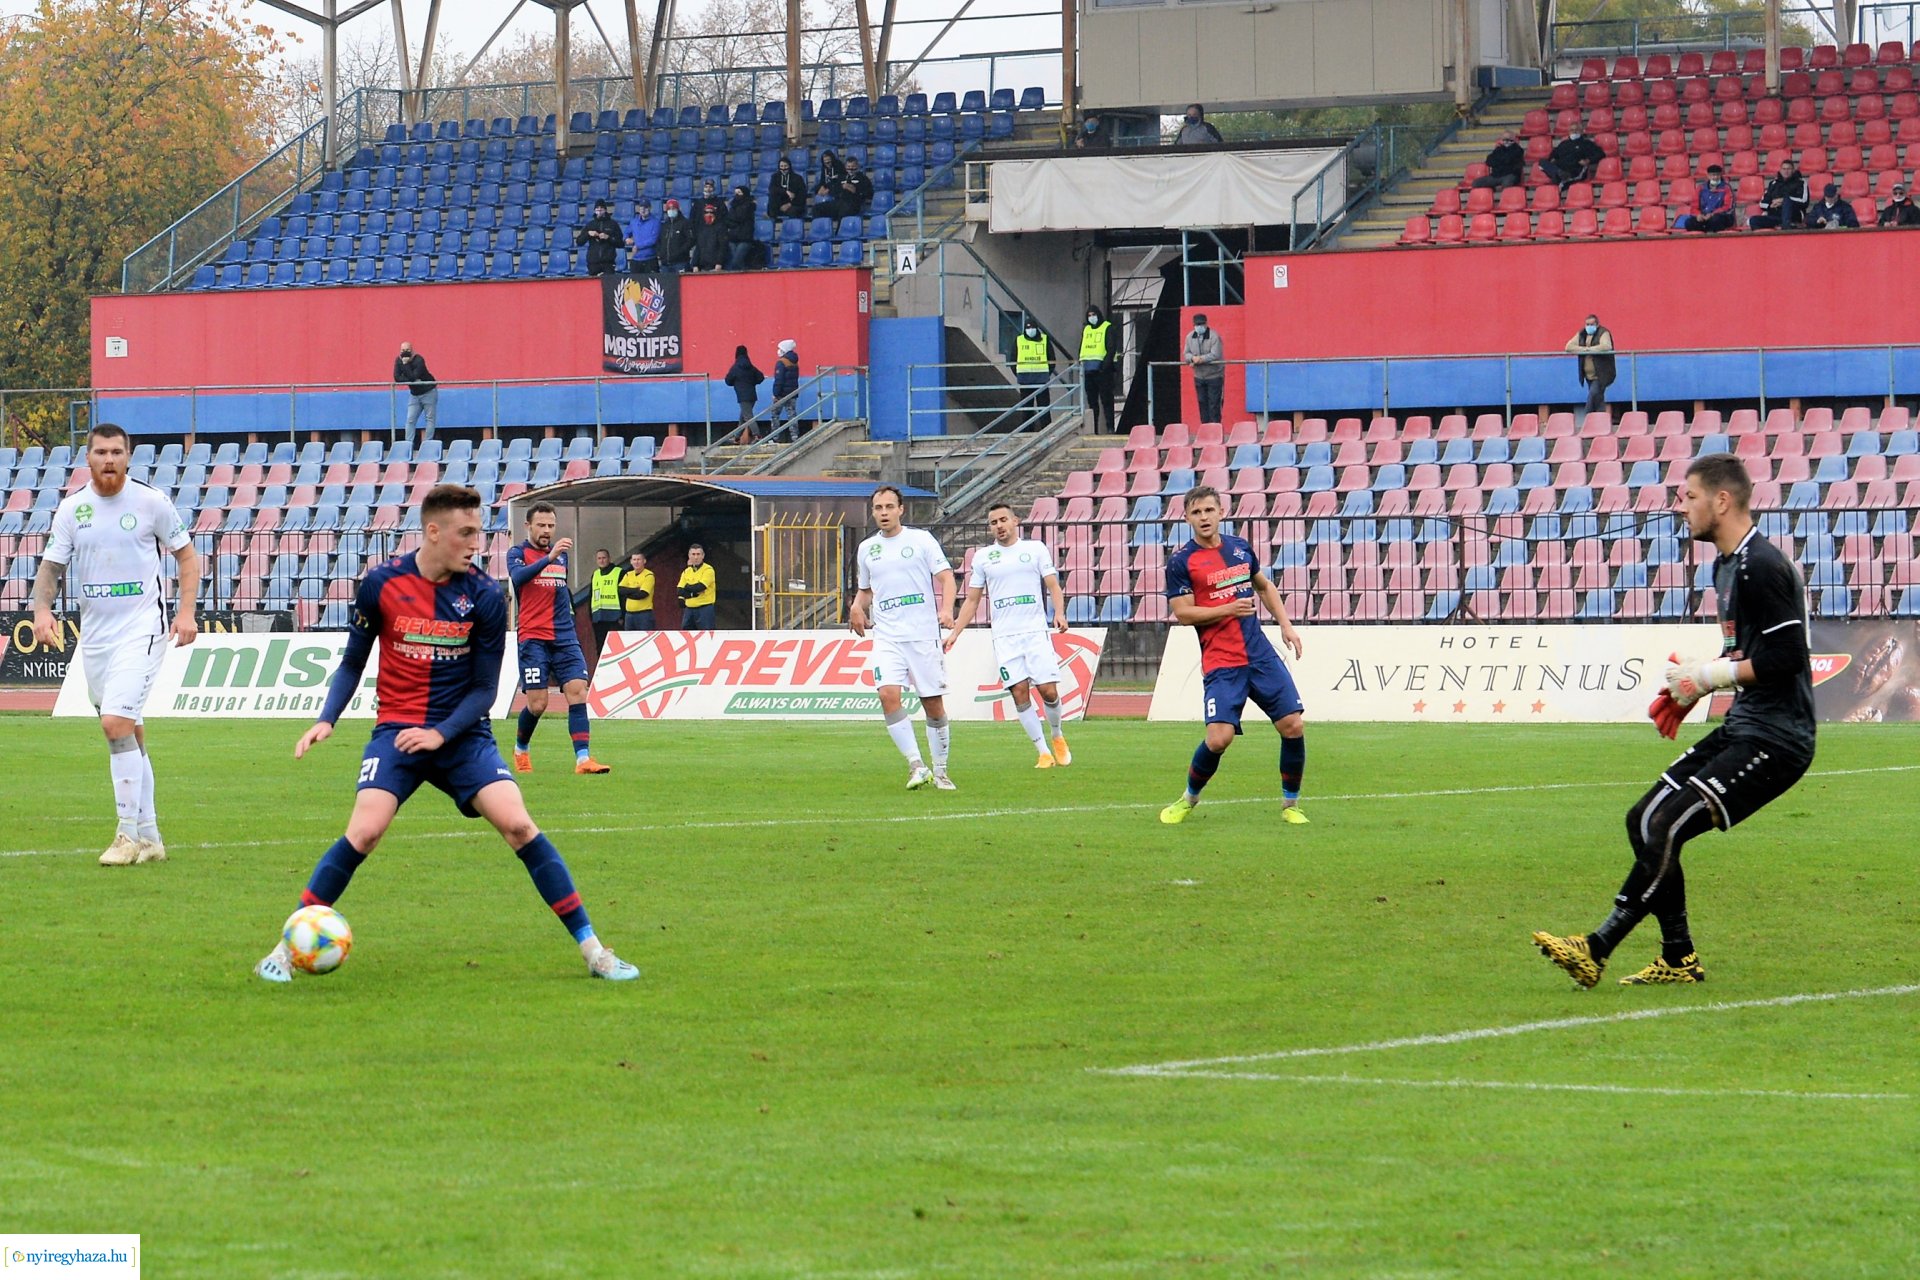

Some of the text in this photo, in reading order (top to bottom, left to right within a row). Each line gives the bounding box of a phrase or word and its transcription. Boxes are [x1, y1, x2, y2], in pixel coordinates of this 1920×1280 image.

[902, 256, 912, 271] A
[963, 286, 972, 309] A
[604, 333, 679, 357] MASTIFFS
[394, 616, 474, 638] REVESZ
[1439, 636, 1548, 649] HOTEL
[700, 640, 950, 686] REVE
[525, 667, 540, 683] 22
[1331, 658, 1644, 691] AVENTINUS
[173, 693, 247, 712] Magyar
[254, 692, 362, 710] Labdaró
[731, 698, 788, 709] ALWAYS
[790, 698, 809, 709] ON
[813, 698, 842, 709] THE
[900, 698, 920, 709] AY
[1207, 698, 1216, 717] 6
[358, 757, 380, 783] 21
